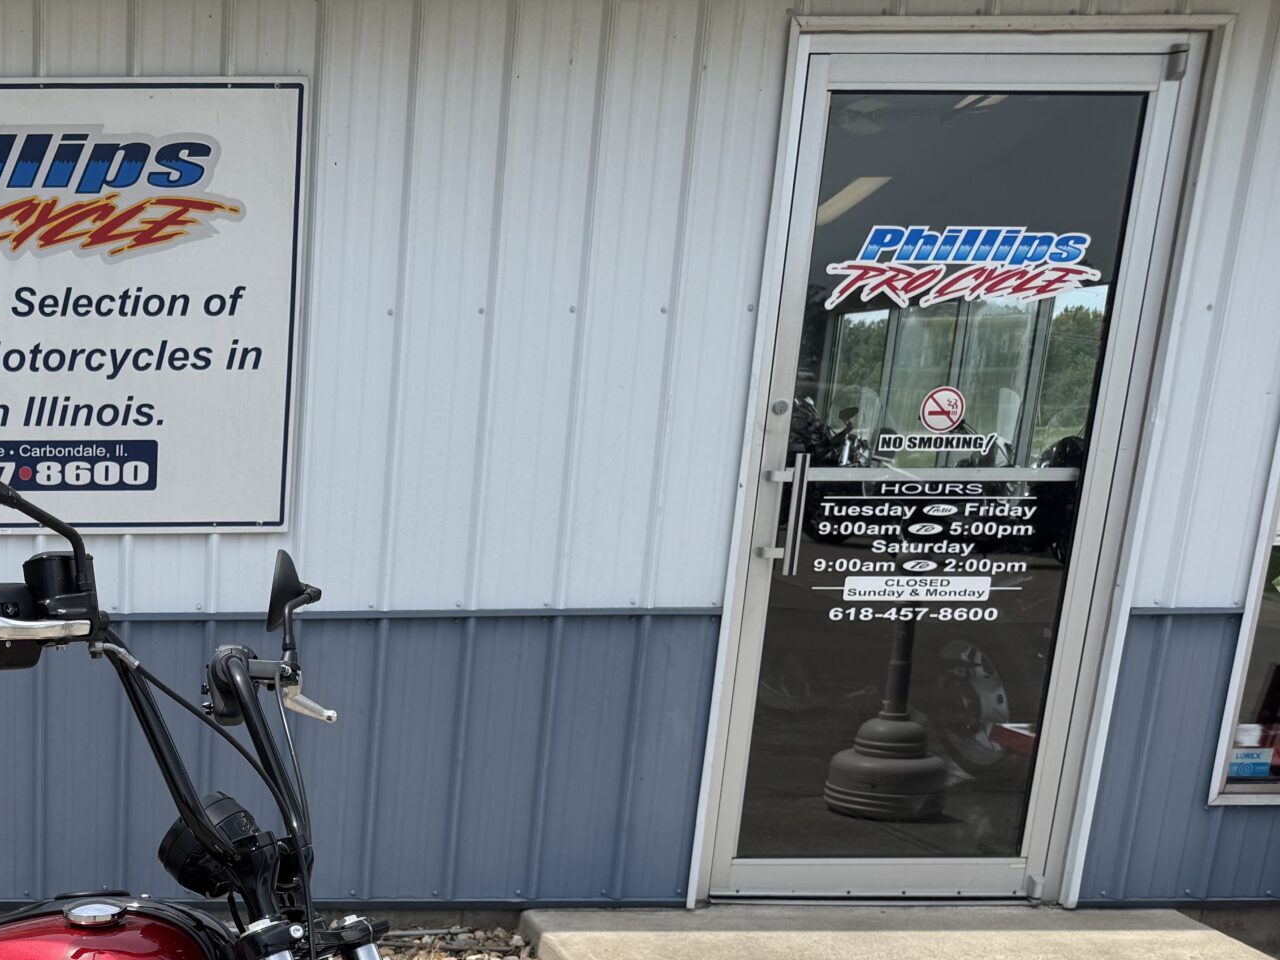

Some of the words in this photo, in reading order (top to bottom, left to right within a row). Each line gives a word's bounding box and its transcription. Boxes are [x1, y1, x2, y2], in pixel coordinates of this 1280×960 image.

[861, 228, 1088, 264] Phillips
[827, 264, 941, 306] PRO
[922, 263, 1100, 305] CYCLE
[12, 286, 190, 317] Selection
[203, 286, 247, 316] of
[226, 341, 263, 371] in
[23, 396, 166, 427] Illinois.
[19, 444, 110, 459] Carbondale,
[879, 436, 904, 449] NO
[906, 434, 997, 454] SMOKING!
[880, 483, 983, 495] HOURS
[821, 503, 917, 520] Tuesday
[964, 503, 1038, 520] Friday
[818, 522, 901, 535] 9:00am
[949, 522, 1033, 538] 5:00pm
[871, 540, 975, 557] Saturday
[813, 559, 896, 572] 9:00am
[943, 559, 1027, 575] 2:00pm
[884, 578, 951, 587] CLOSED
[847, 588, 904, 598] Sunday
[909, 588, 920, 597] &
[925, 588, 985, 598] Monday
[829, 607, 999, 621] 618-457-8600
